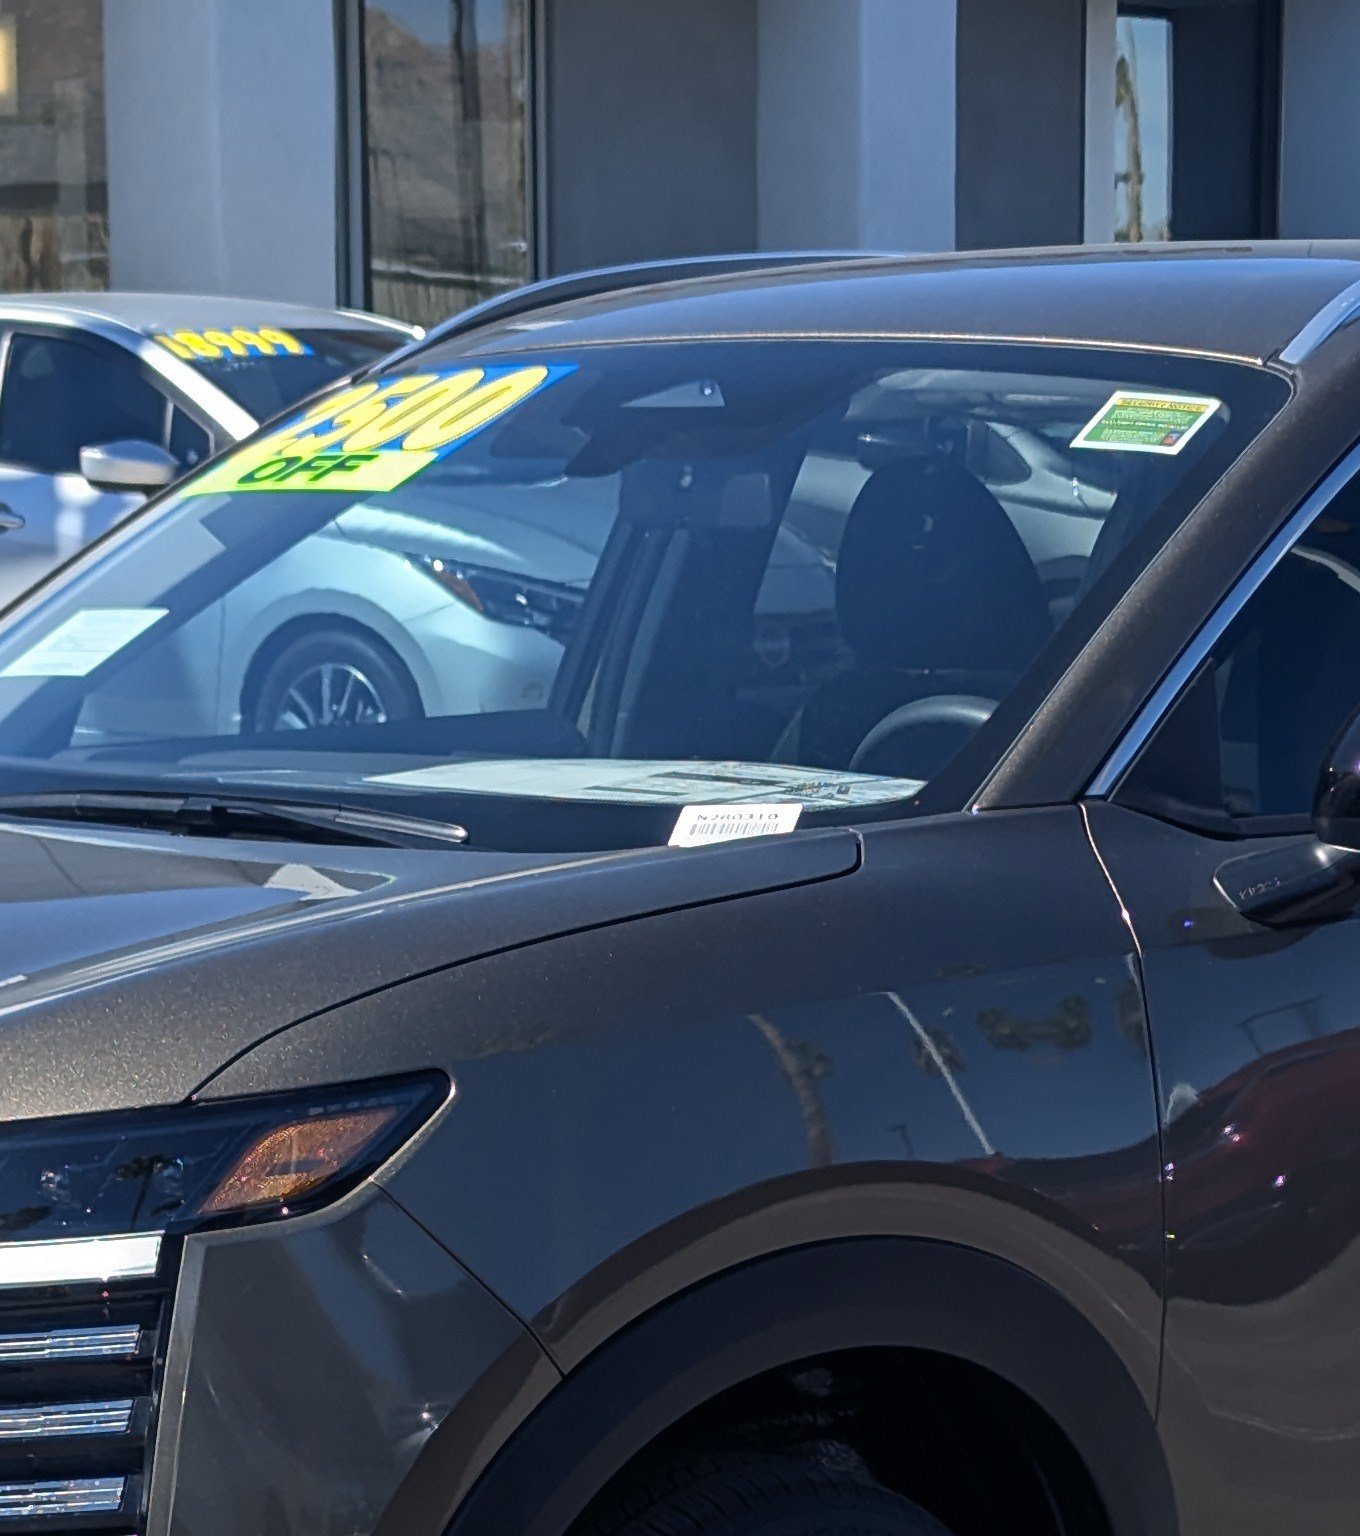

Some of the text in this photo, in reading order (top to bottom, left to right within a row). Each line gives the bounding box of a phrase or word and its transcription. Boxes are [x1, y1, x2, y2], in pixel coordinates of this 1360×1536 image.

[153, 327, 304, 359] 18999
[238, 366, 549, 456] 2500
[237, 454, 380, 485] OFF
